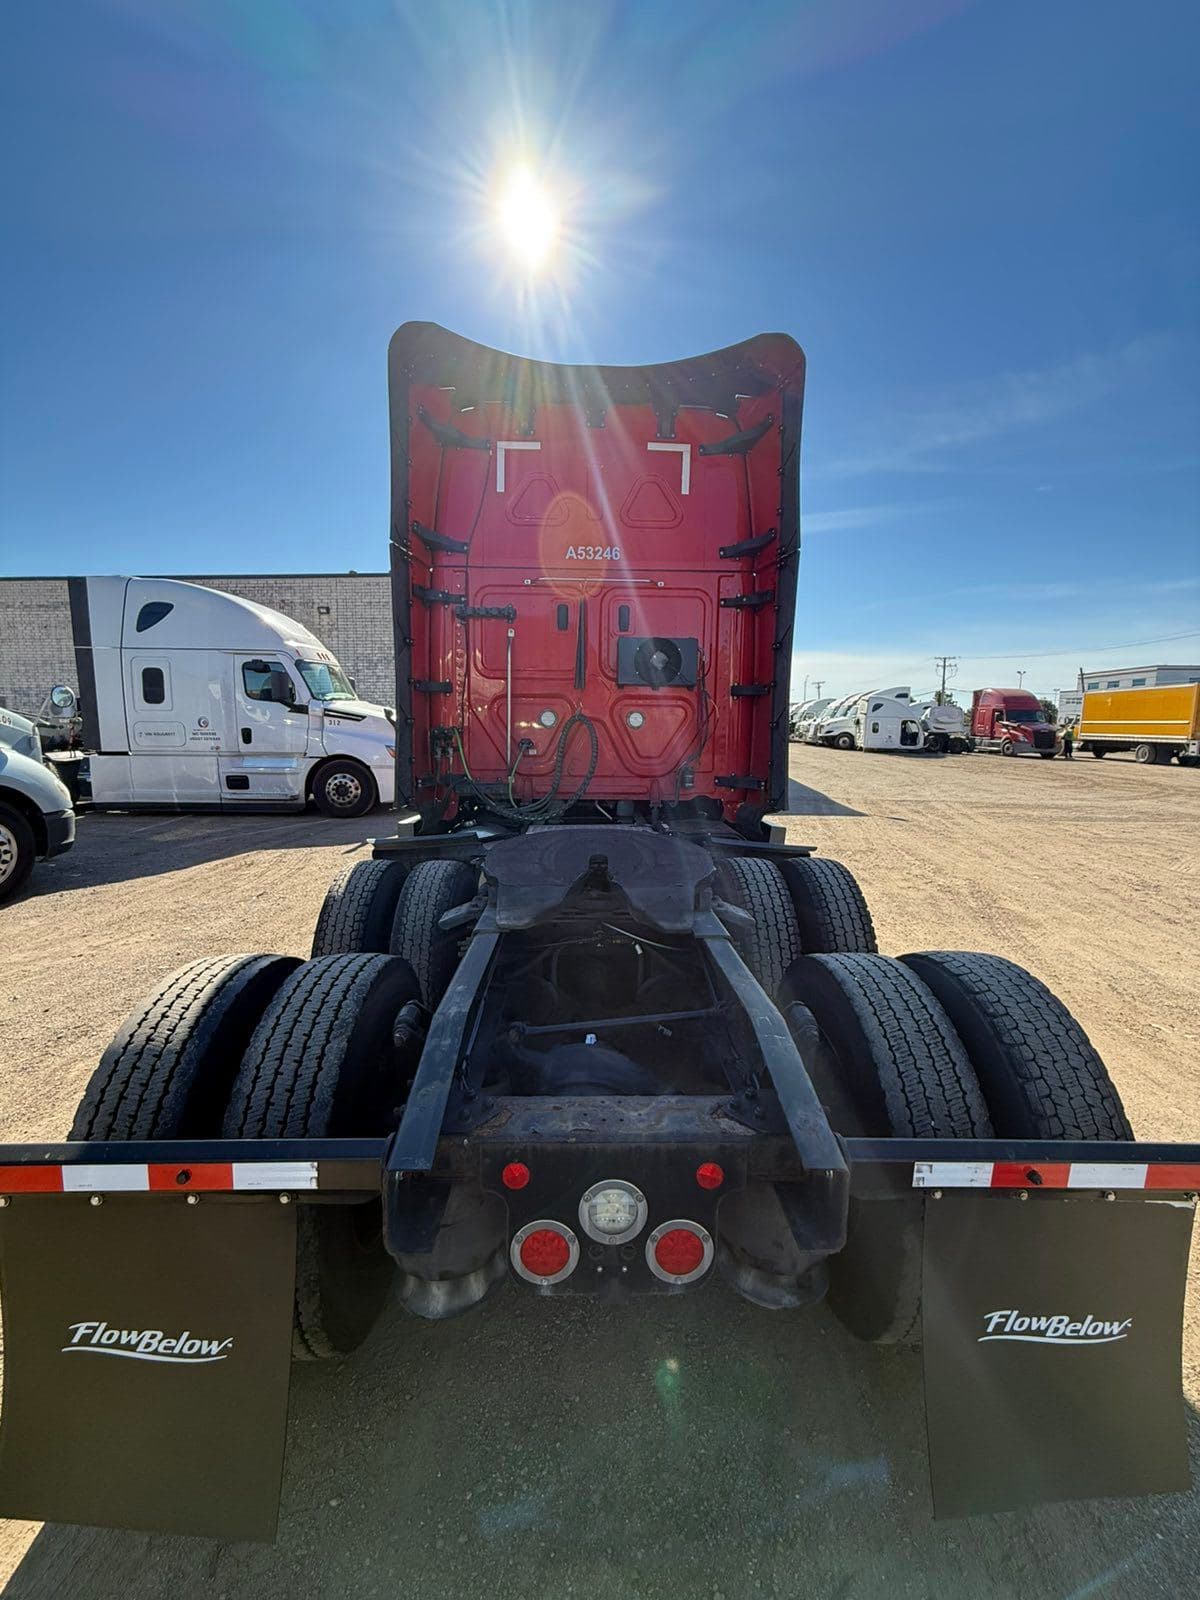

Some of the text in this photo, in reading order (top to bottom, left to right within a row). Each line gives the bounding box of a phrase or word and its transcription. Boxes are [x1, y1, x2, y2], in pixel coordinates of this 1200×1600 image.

[565, 545, 621, 560] A53246
[983, 1310, 1133, 1337] FlowBelow
[69, 1321, 233, 1356] FlowBelow
